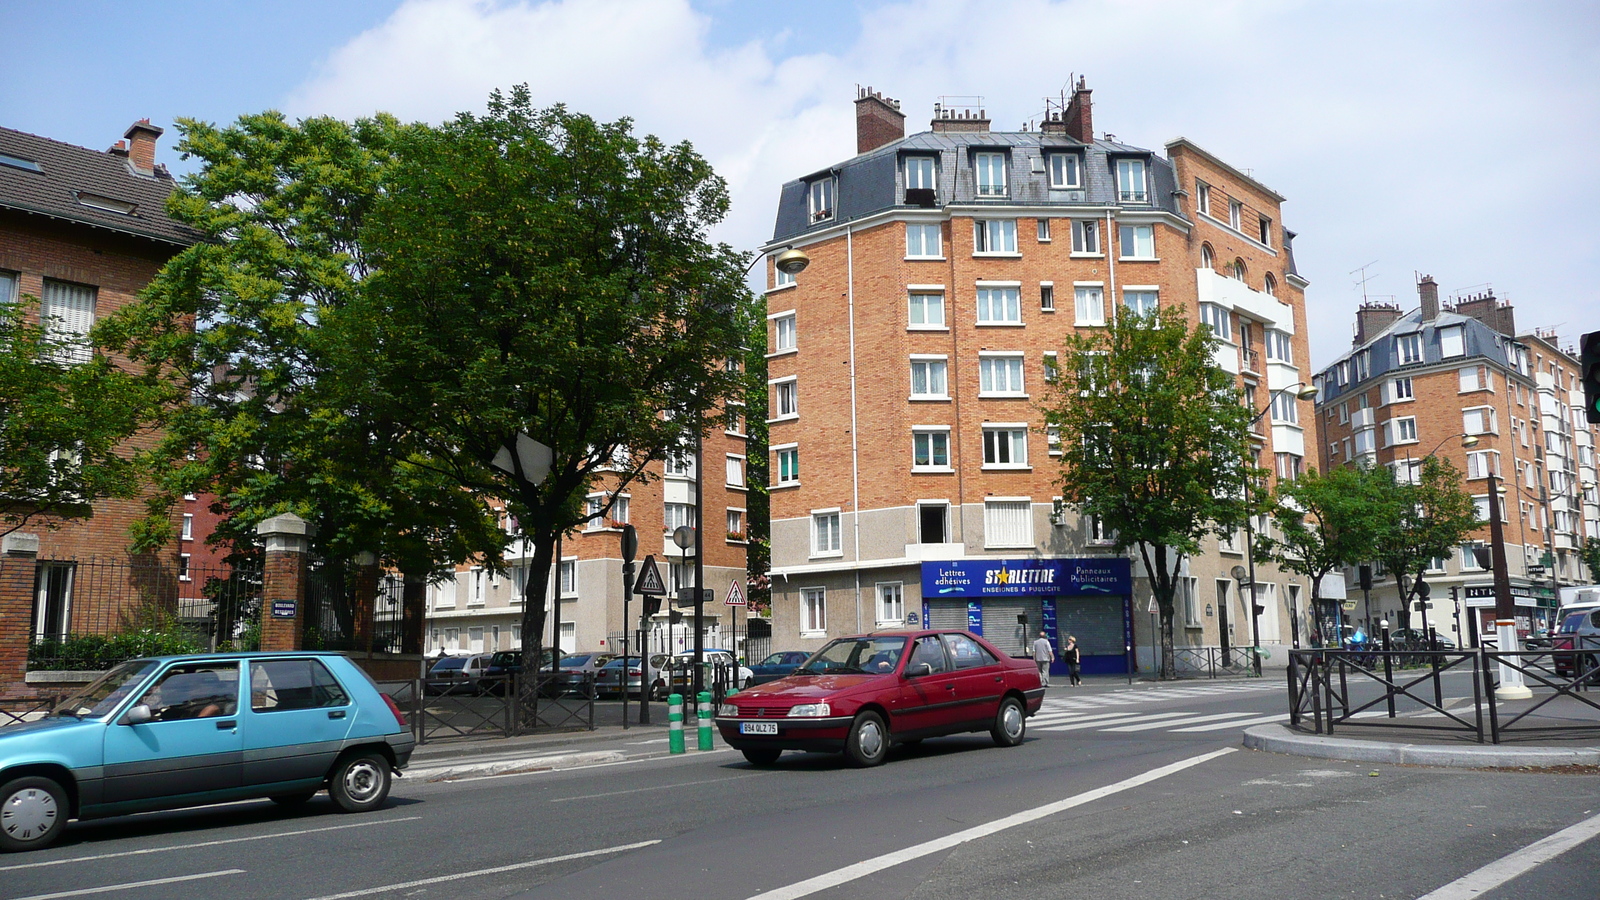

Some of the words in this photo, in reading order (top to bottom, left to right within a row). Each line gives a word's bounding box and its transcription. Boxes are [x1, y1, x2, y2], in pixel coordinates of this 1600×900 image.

[939, 568, 965, 577] Lettres
[1076, 566, 1111, 575] Panneaux
[985, 567, 1055, 585] STRLETTRE
[1070, 574, 1118, 583] Publicitaires
[935, 577, 970, 585] adhésives
[744, 723, 754, 732] 894
[768, 724, 776, 733] 75
